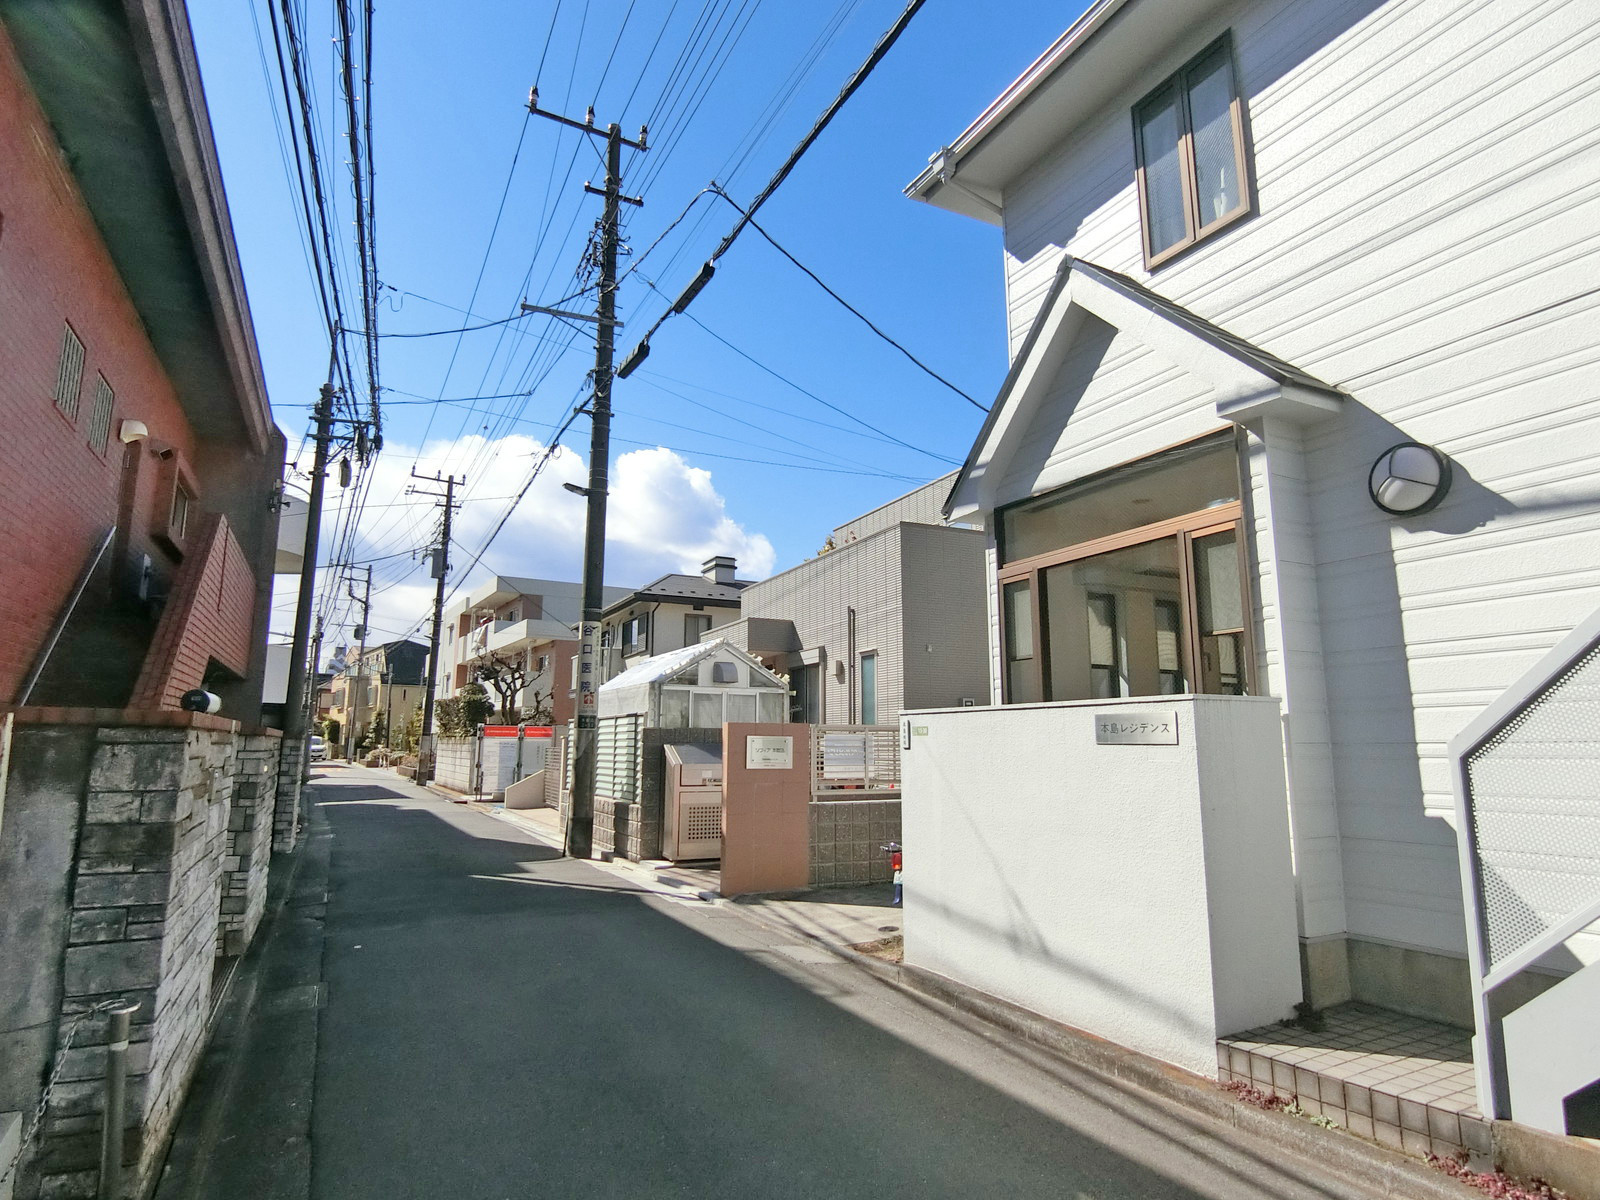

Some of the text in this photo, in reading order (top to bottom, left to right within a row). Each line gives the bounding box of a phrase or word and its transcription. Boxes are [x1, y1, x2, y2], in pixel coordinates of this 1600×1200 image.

[581, 625, 594, 693] 谷口医院
[1100, 722, 1170, 734] 本島レジデンス
